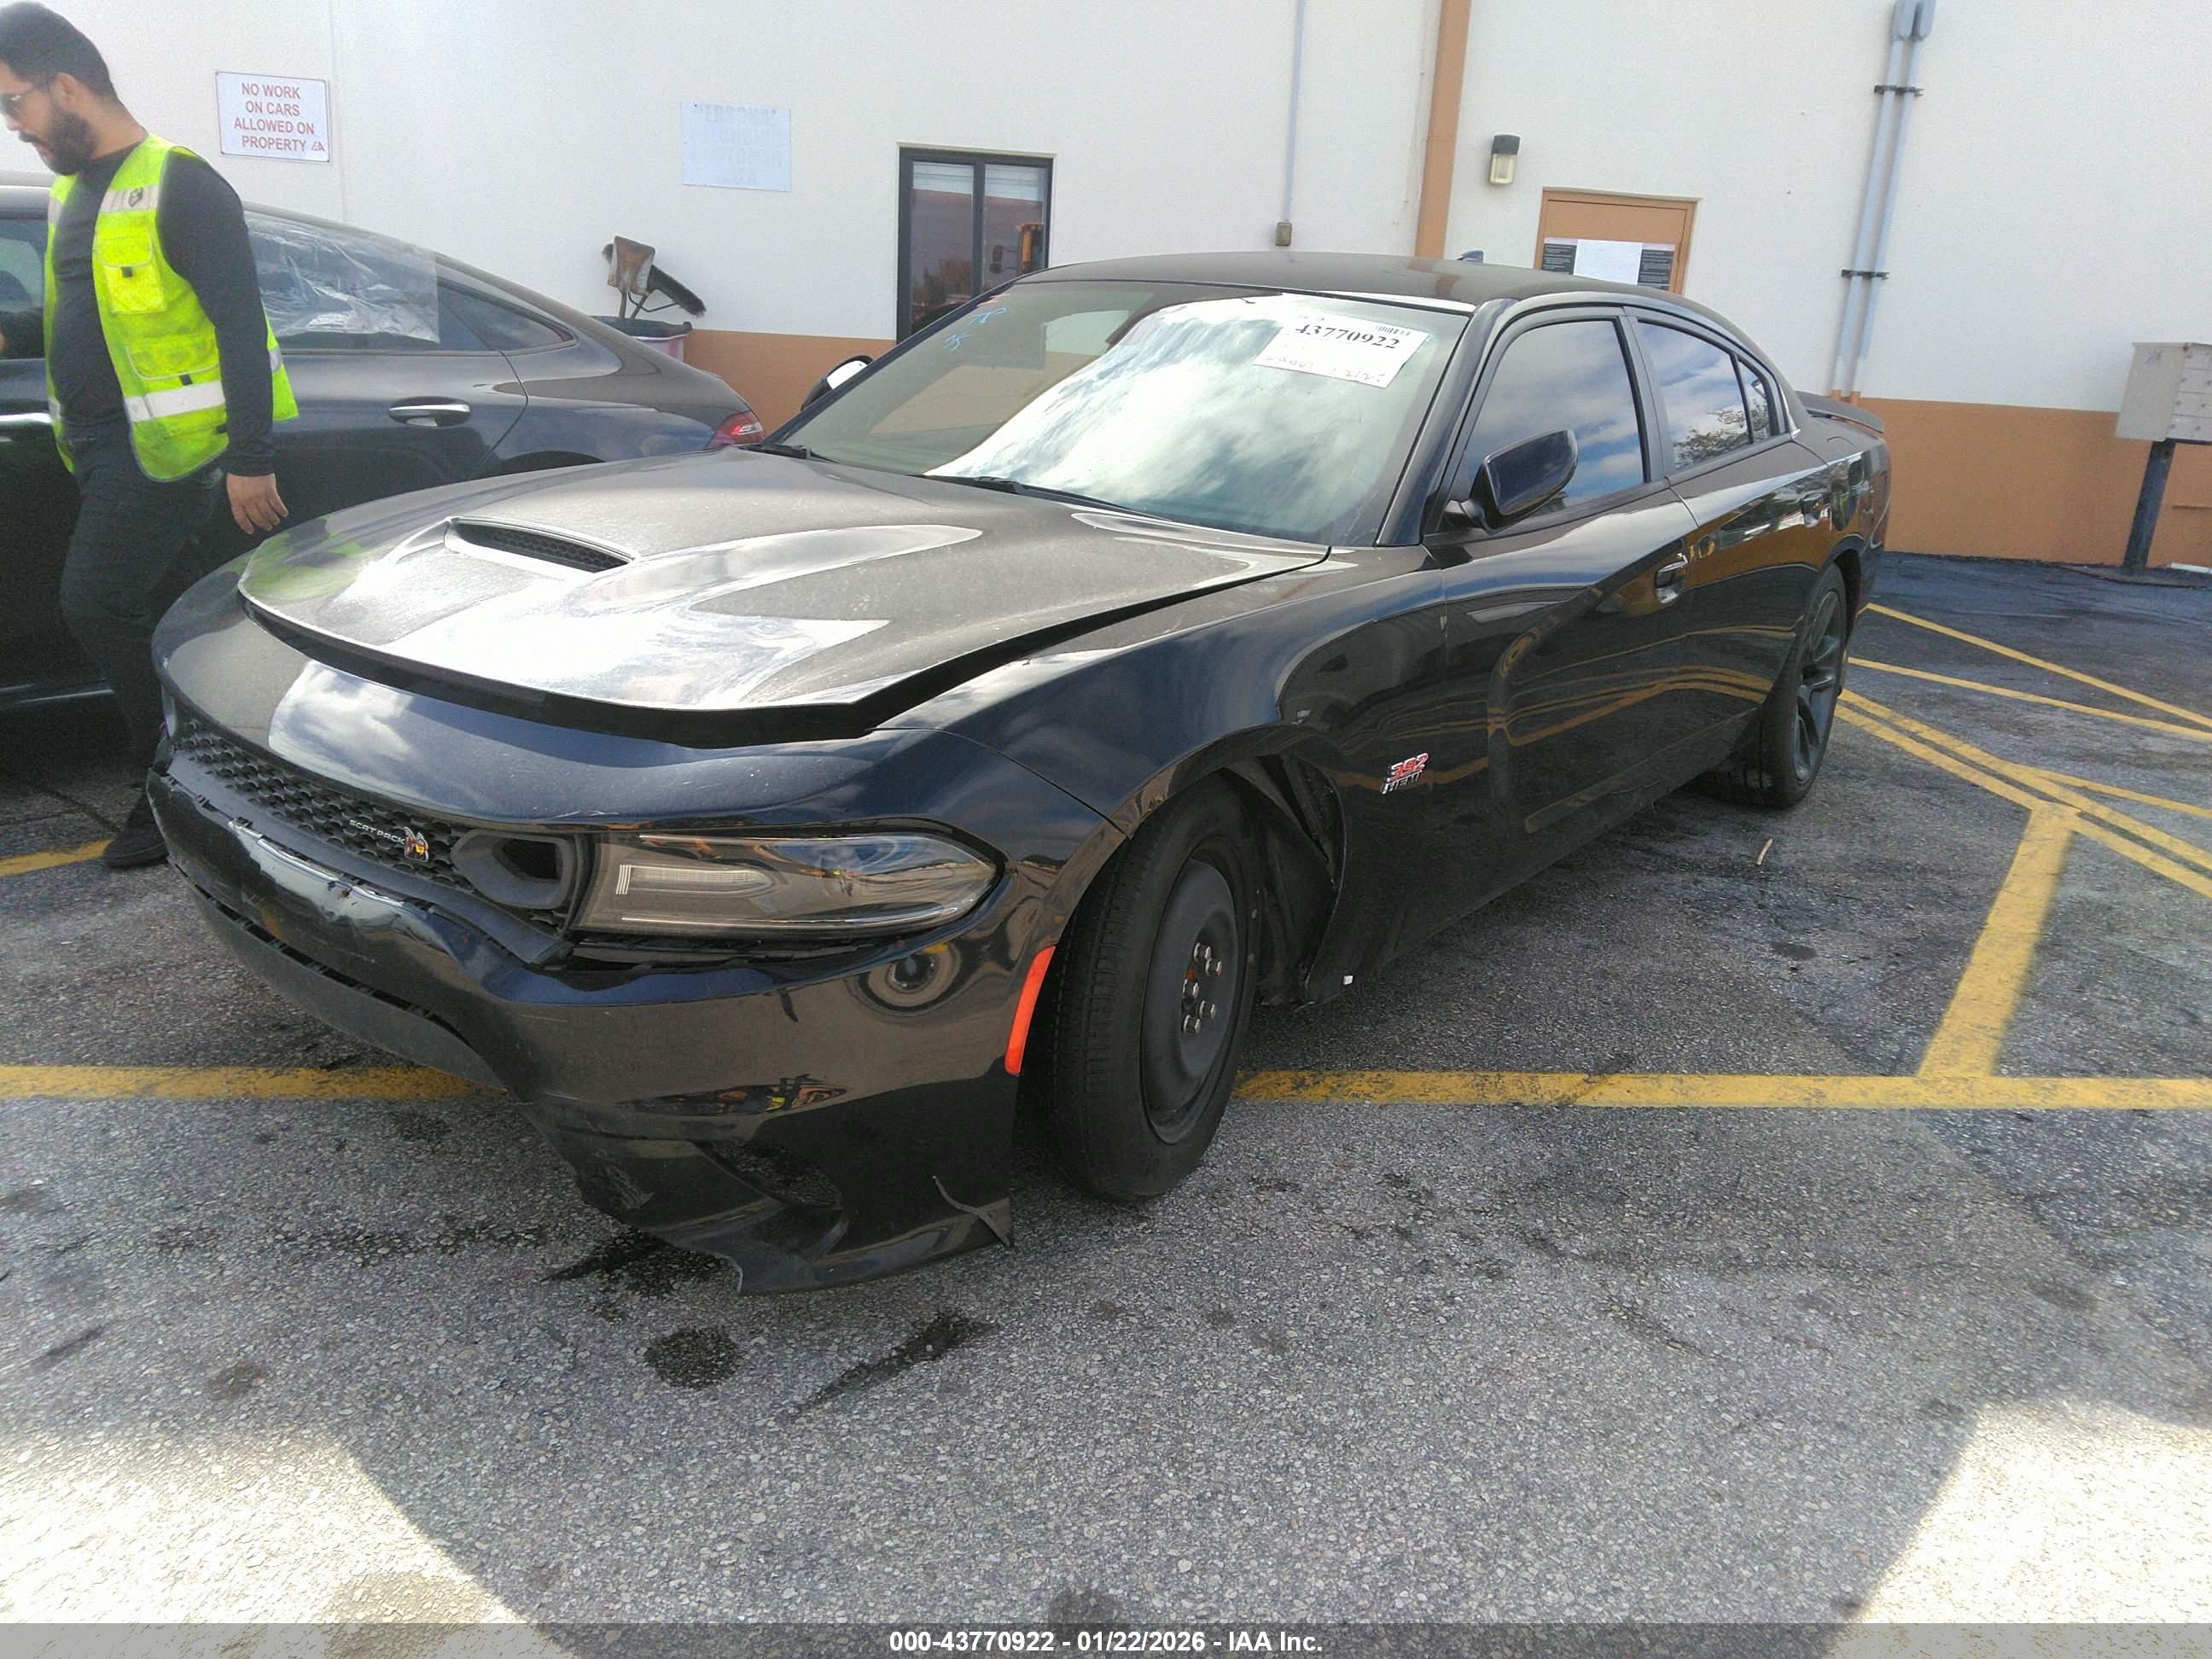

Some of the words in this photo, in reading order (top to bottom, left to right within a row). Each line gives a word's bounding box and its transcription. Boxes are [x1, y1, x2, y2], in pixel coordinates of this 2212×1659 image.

[242, 82, 259, 96] NO
[262, 84, 301, 99] WORK
[245, 100, 263, 114] ON
[266, 102, 300, 117] CARS
[234, 117, 294, 133] ALLOWED
[296, 122, 315, 135] ON
[242, 135, 306, 152] PROPERTY
[1295, 323, 1400, 349] 43770922
[1387, 753, 1429, 783] 392
[349, 819, 375, 833] SCAT
[376, 830, 405, 845] PACK
